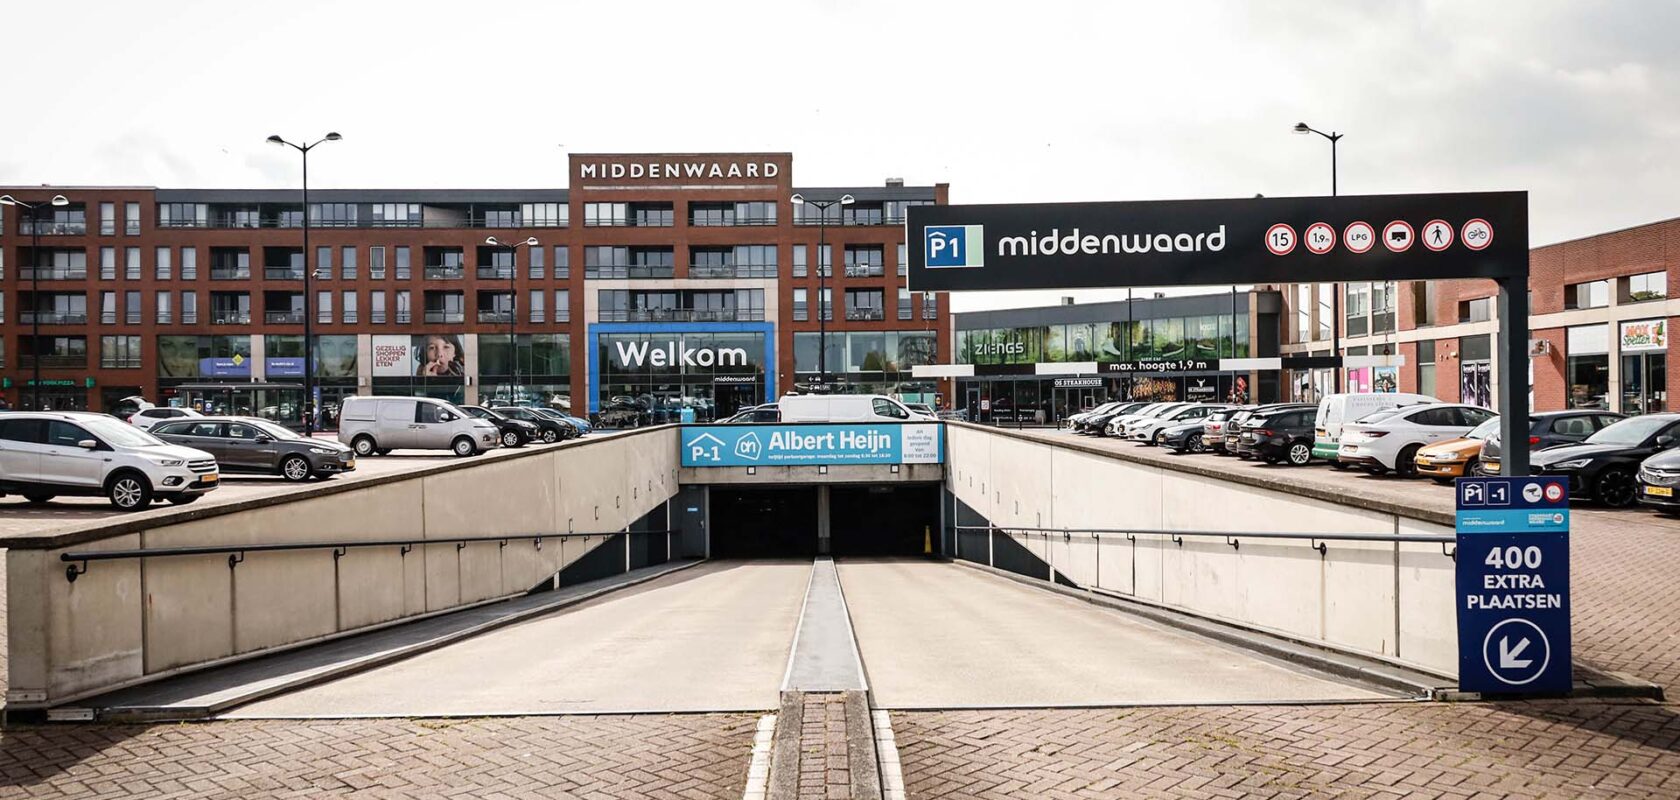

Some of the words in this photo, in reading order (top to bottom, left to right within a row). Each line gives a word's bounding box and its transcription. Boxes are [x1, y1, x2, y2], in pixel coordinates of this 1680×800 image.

[580, 162, 779, 179] MIDDENWAARD
[998, 224, 1226, 256] middenwaard
[1272, 232, 1289, 247] 15
[1351, 233, 1368, 241] LPG
[930, 237, 958, 258] P1
[616, 341, 747, 367] Welkom
[1109, 363, 1136, 371] max.
[1139, 361, 1177, 372] hoogte
[1179, 360, 1194, 371] 1,9
[1196, 361, 1207, 369] m
[768, 431, 835, 451] Albert
[840, 429, 891, 453] Heijn
[692, 446, 721, 462] P-1
[1464, 488, 1483, 502] P1
[1491, 487, 1505, 501] -1
[1484, 545, 1542, 570] 400
[1483, 574, 1545, 589] EXTRA
[1466, 594, 1561, 610] PLAATSEN
